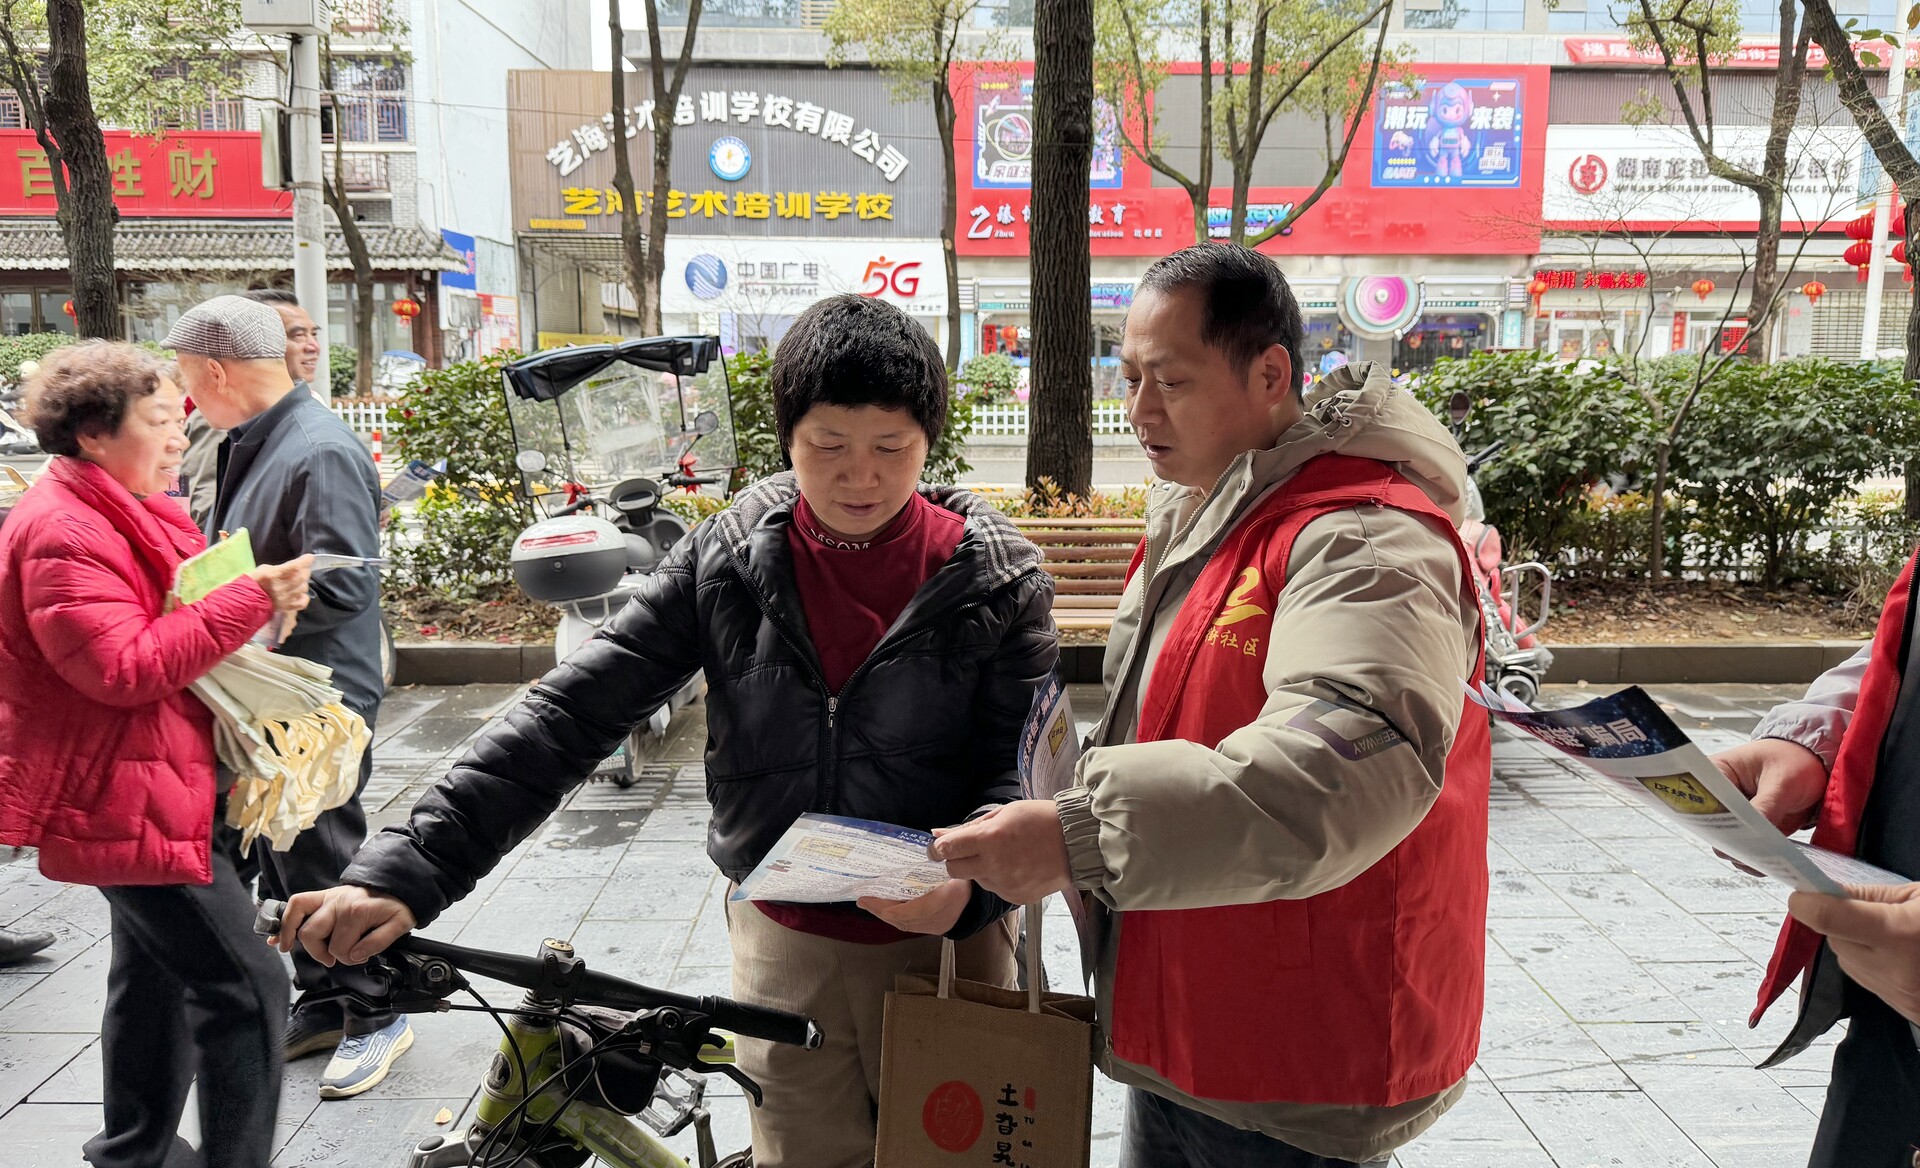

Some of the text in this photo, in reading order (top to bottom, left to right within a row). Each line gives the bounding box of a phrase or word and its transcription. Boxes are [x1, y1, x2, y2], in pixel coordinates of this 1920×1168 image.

[736, 260, 819, 280] 中国广电
[858, 255, 923, 298] 5G
